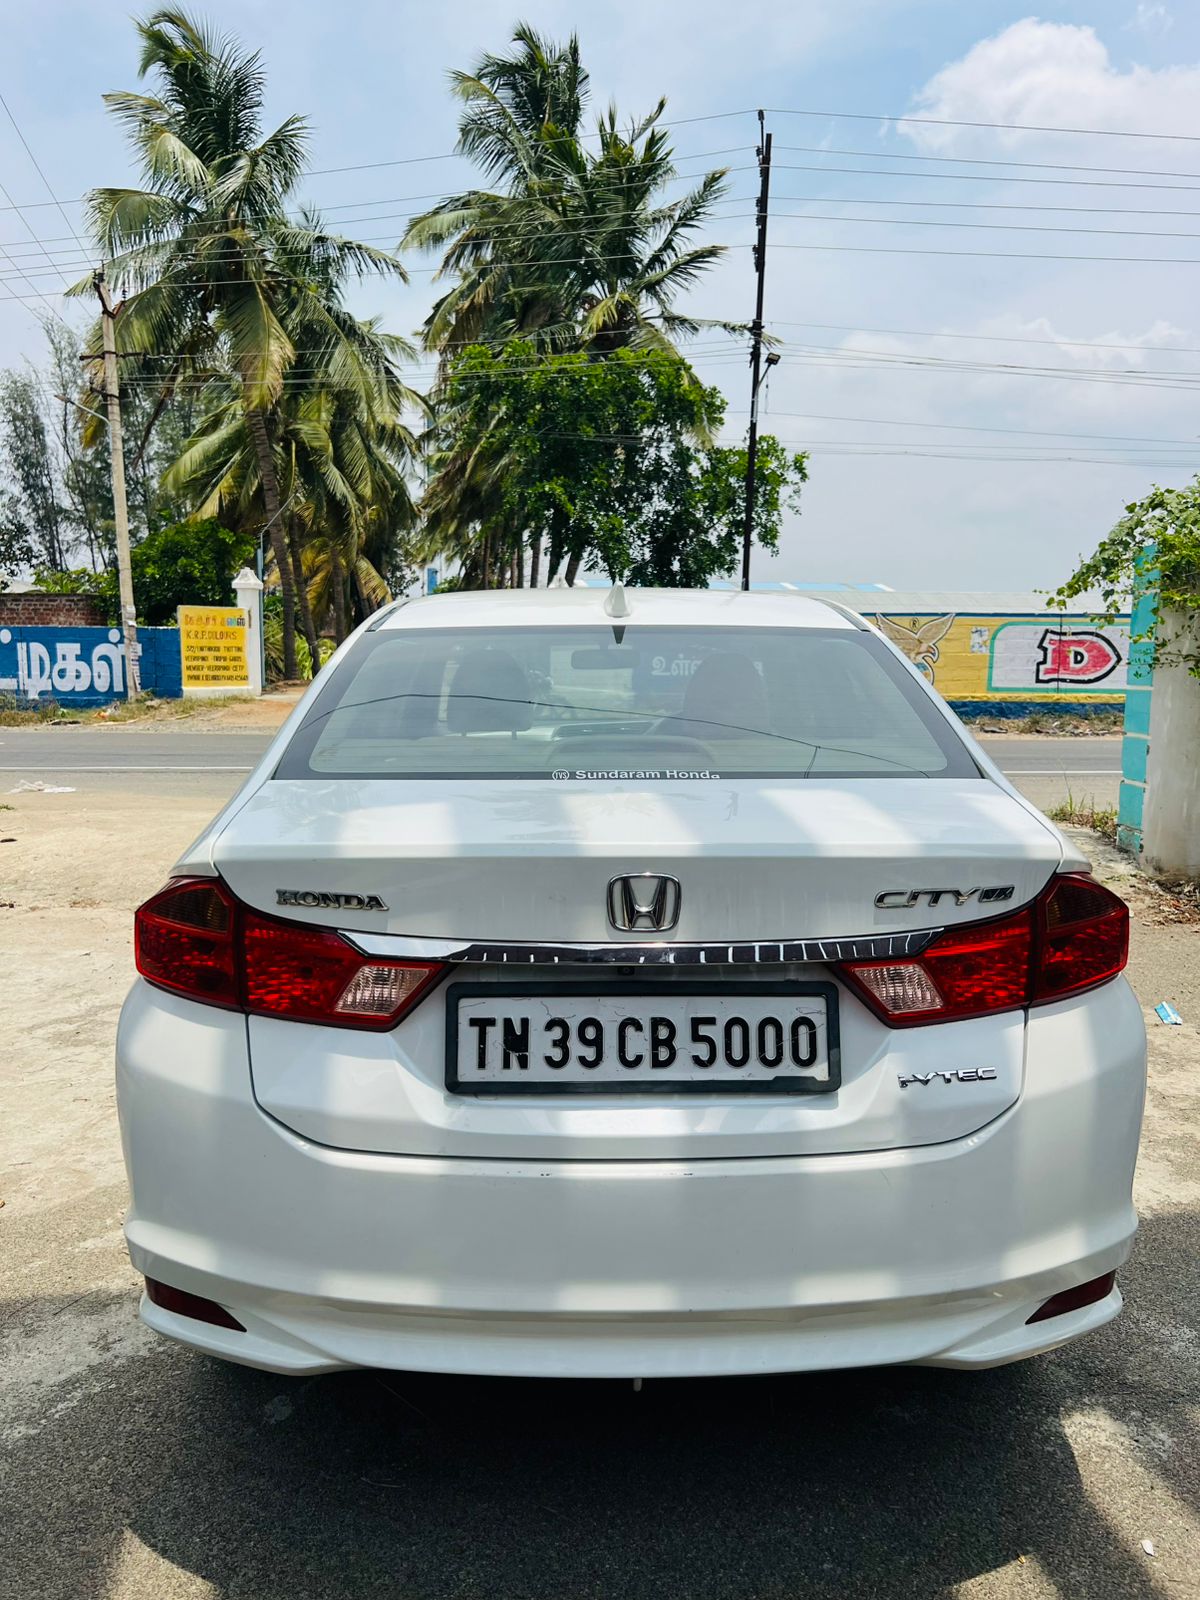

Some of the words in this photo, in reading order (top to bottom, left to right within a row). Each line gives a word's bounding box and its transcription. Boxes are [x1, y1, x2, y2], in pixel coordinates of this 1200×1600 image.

[575, 770, 660, 780] Sundaram
[276, 889, 389, 912] HONDA
[874, 887, 980, 908] CITY
[469, 1017, 529, 1069] TN
[543, 1017, 604, 1069] 39
[617, 1017, 677, 1069] CB
[690, 1016, 817, 1069] 5000
